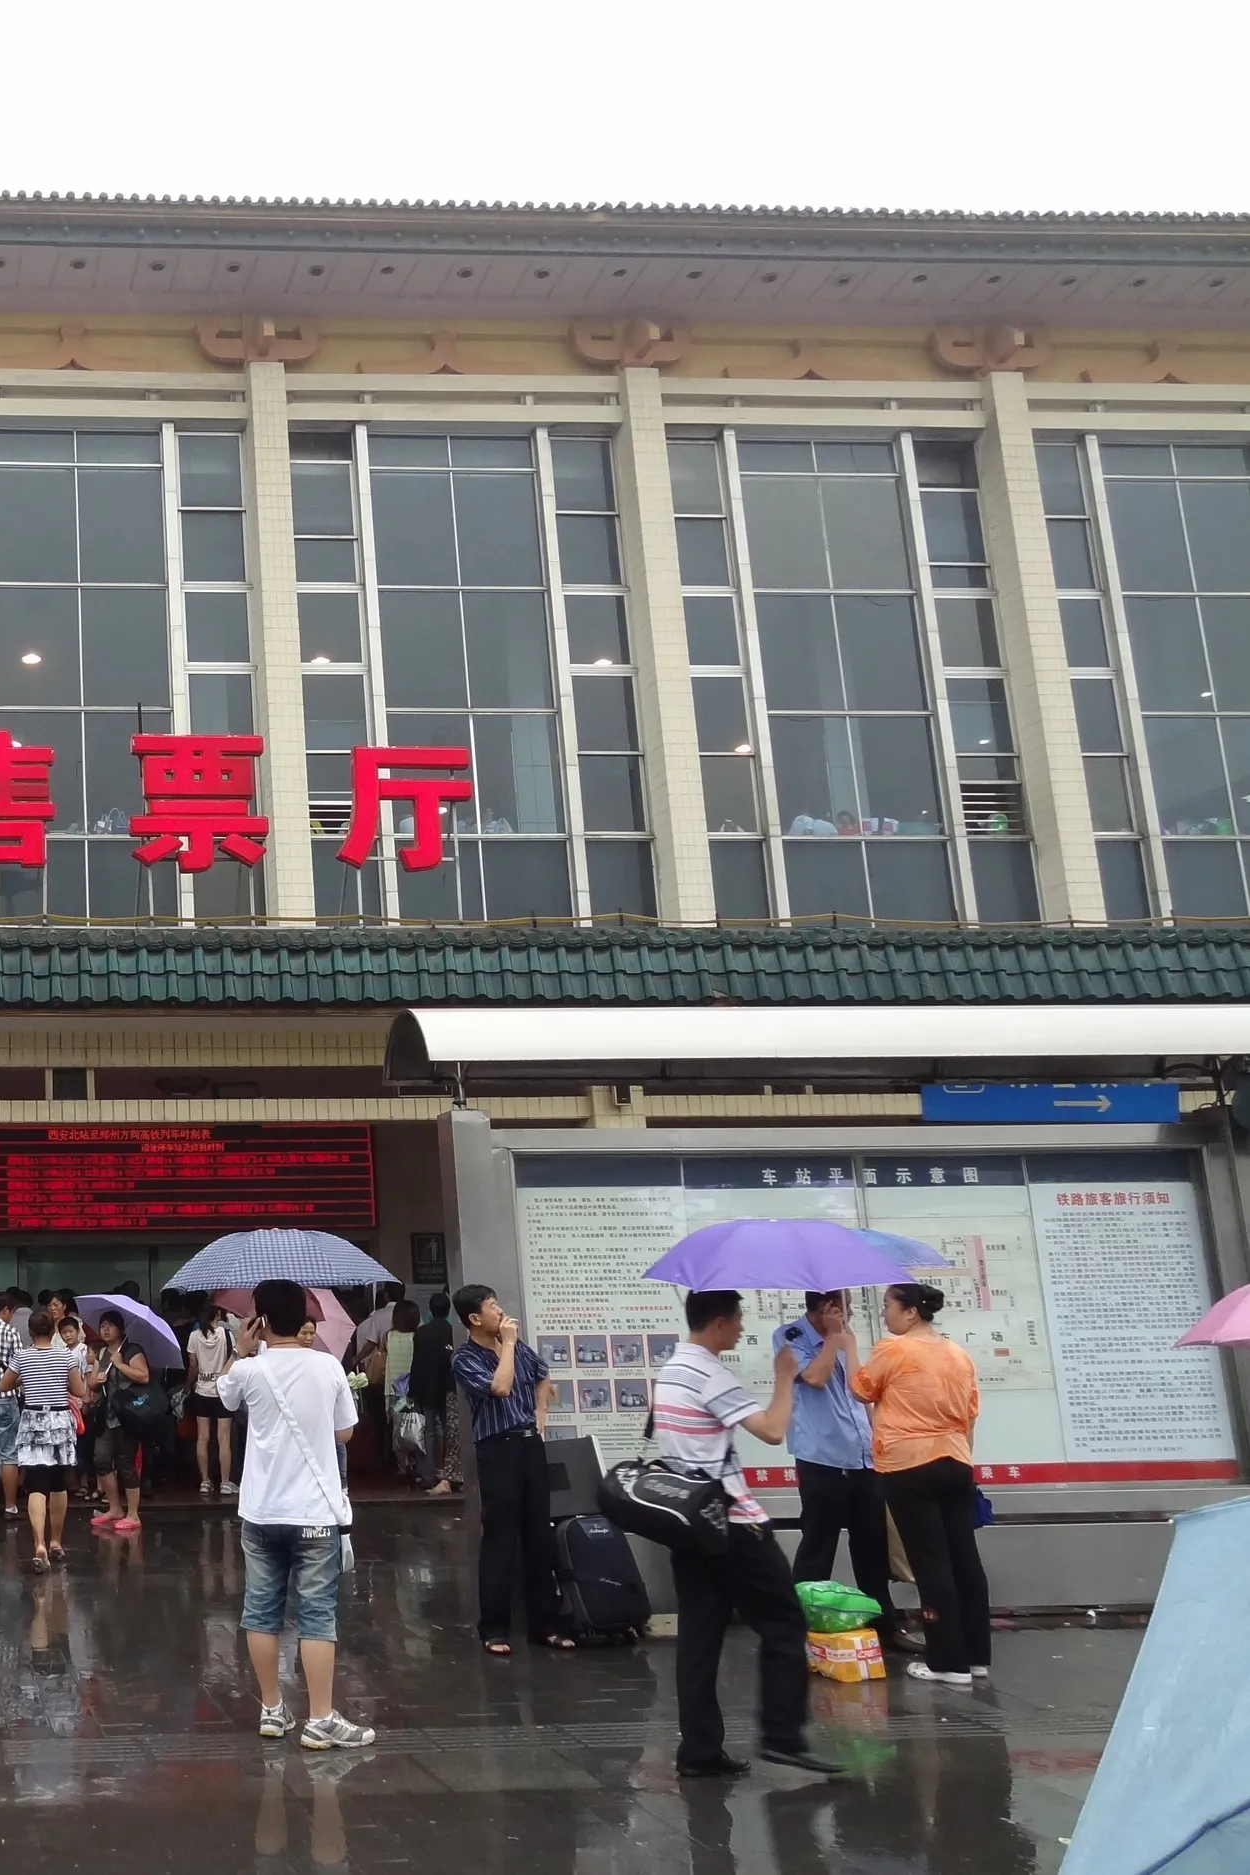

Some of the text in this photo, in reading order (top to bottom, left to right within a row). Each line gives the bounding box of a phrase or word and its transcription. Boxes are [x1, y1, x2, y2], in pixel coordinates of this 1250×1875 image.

[48, 1129, 211, 1141] 西安北站至郑州方向高铁列车时刻表
[761, 1167, 979, 1186] 车站平面示意图
[1056, 1192, 1171, 1207] 铁路旅客旅行须知
[746, 1334, 759, 1346] 西
[981, 1465, 1021, 1479] 乘车
